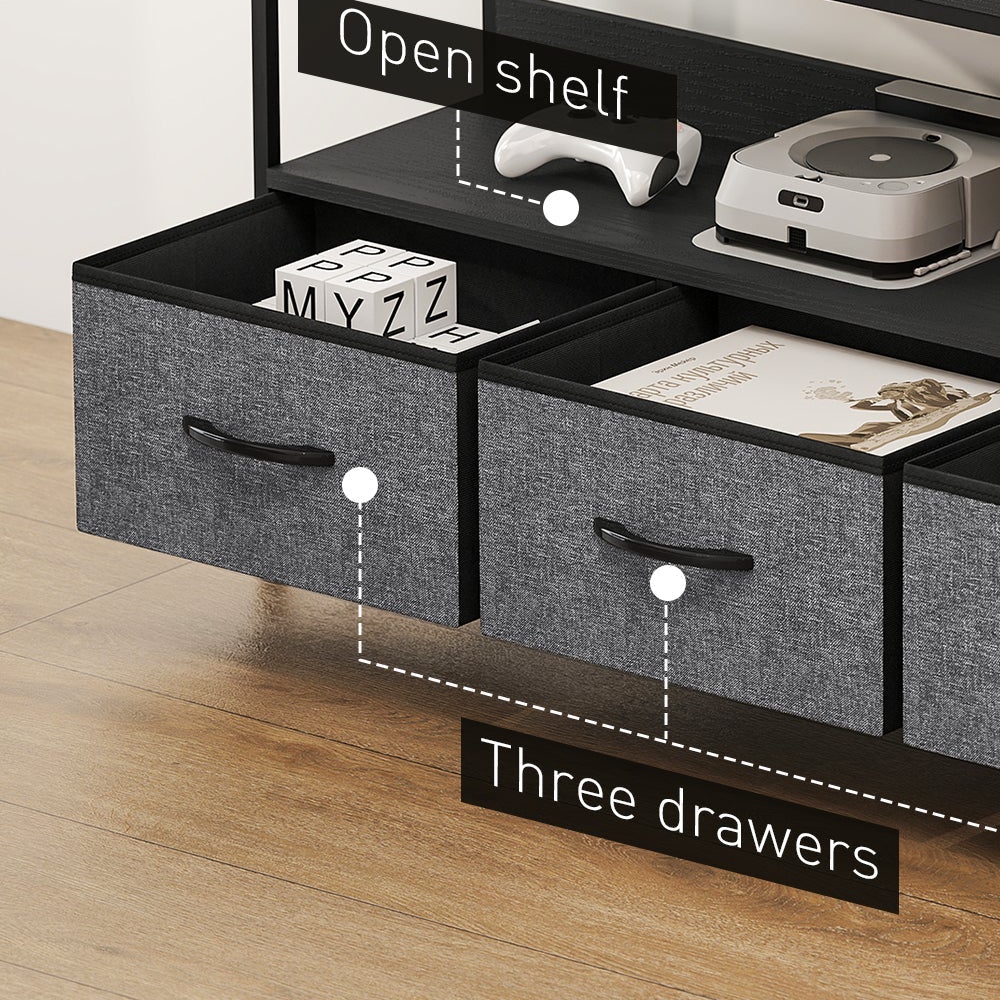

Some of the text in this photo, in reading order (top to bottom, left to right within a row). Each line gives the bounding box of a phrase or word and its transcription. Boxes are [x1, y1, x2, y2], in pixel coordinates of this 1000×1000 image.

[339, 244, 387, 256] P
[296, 259, 344, 271] P
[388, 256, 435, 268] P
[345, 271, 393, 283] P
[628, 380, 680, 399] арта
